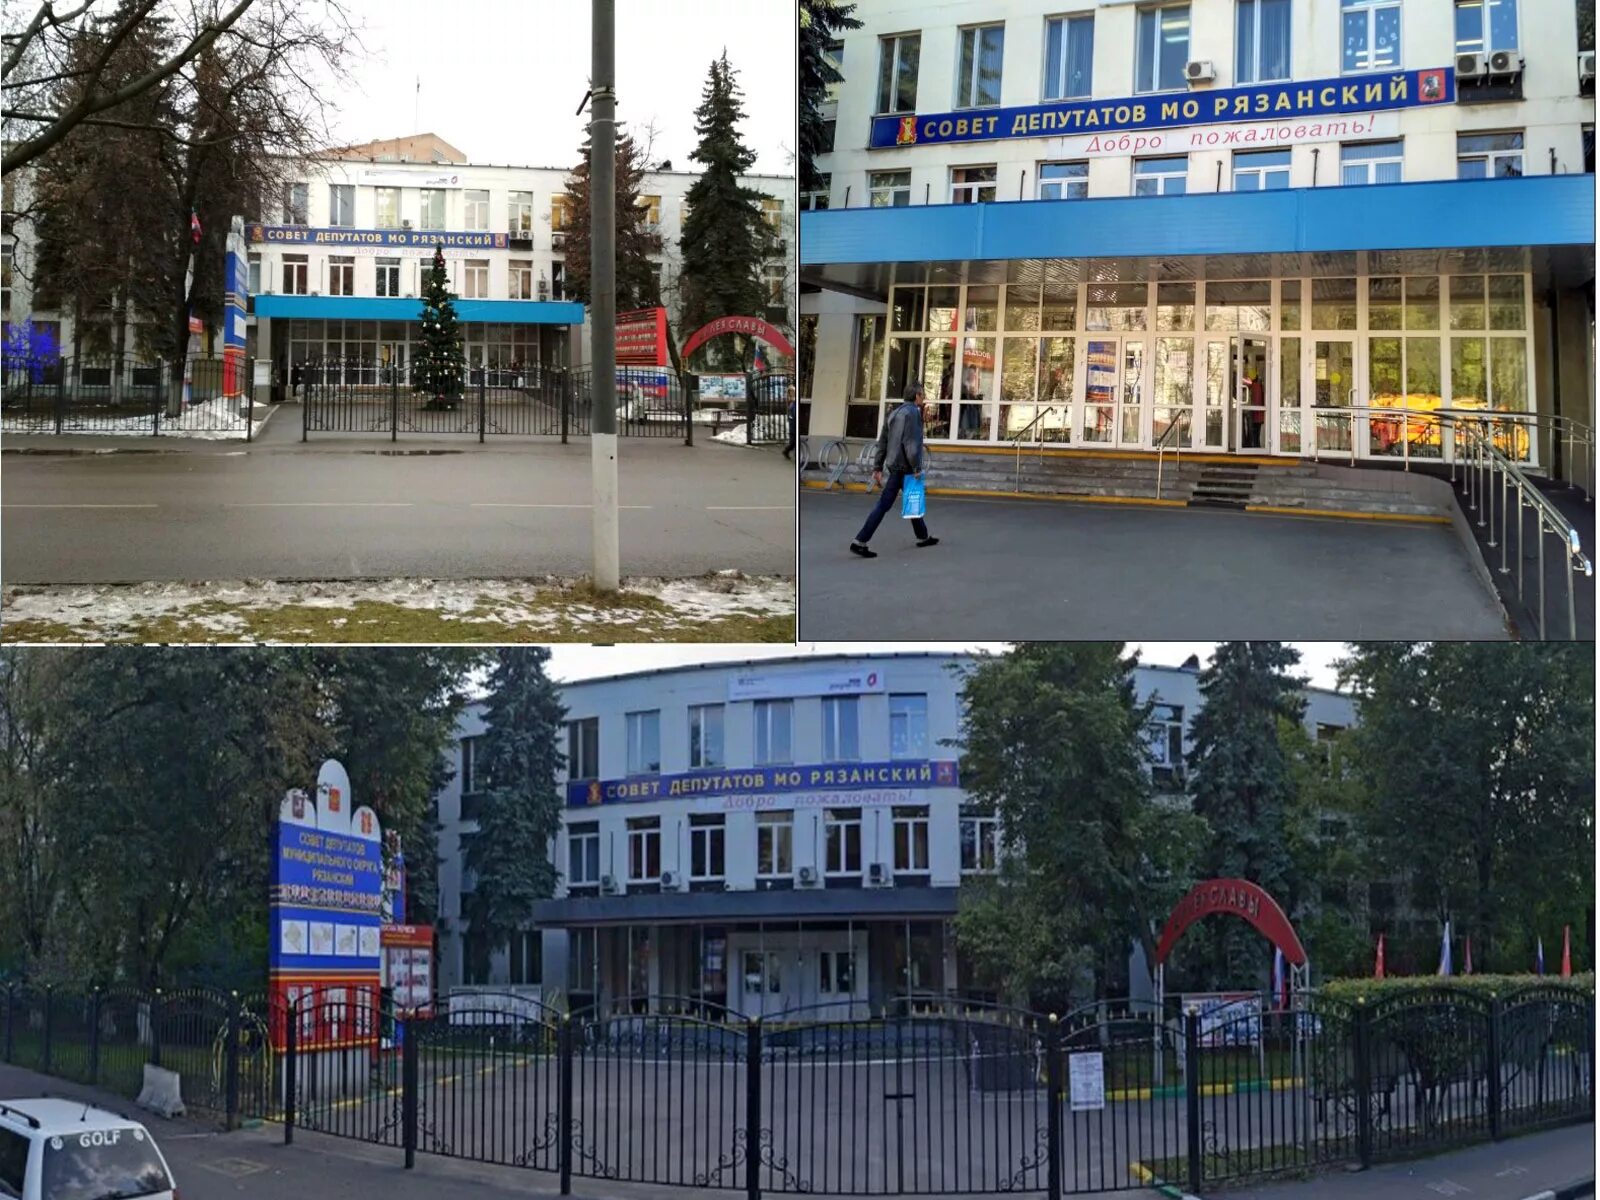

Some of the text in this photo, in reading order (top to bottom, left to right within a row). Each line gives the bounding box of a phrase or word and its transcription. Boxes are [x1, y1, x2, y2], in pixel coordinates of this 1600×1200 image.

[923, 76, 1408, 138] СОВЕТ ДЕПУТАТОВ МО РЯЗАНСКИЙ
[1085, 113, 1376, 155] Добро пожаловать!
[267, 230, 492, 246] СОВЕТ ДЕПУТАТОВ МО РЯЗАНСКИЙ
[728, 319, 766, 336] СЛАВЫ
[606, 764, 932, 798] СОВЕТ ДЕПУТАТОВ МО РЯЗАНСКИЙ
[722, 796, 776, 811] Добро
[1210, 886, 1260, 918] СЛАВЫ
[80, 1130, 120, 1148] GOLF
